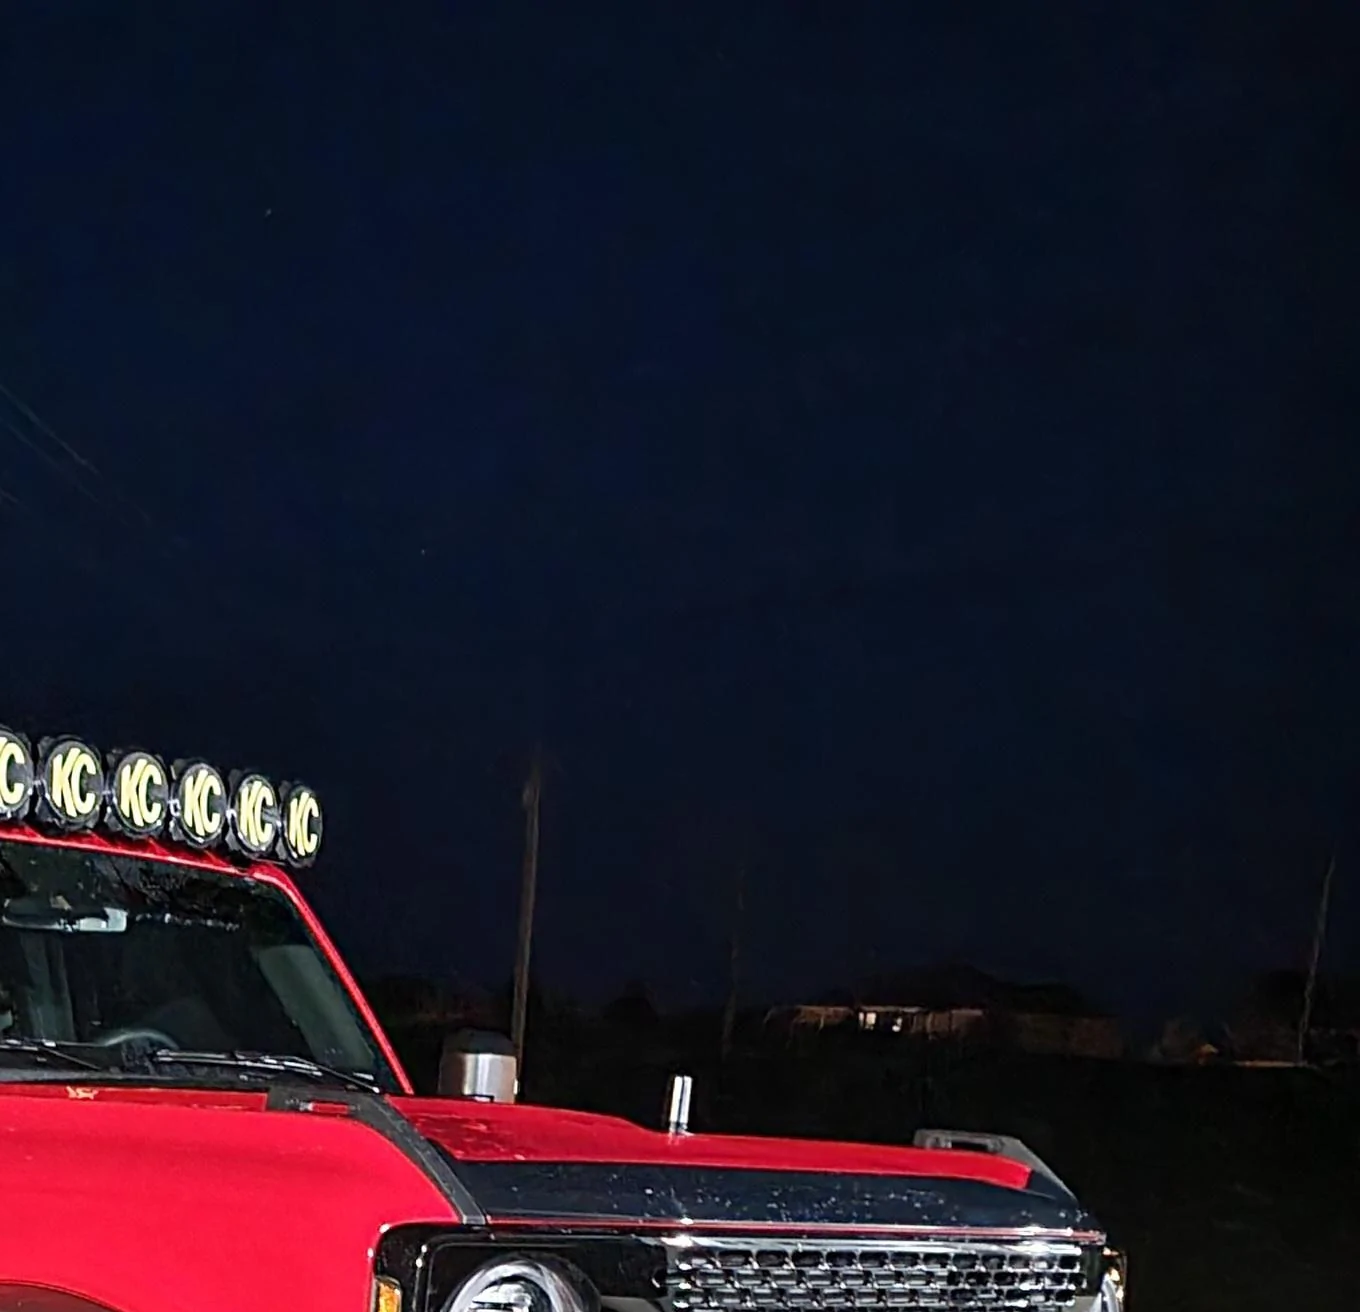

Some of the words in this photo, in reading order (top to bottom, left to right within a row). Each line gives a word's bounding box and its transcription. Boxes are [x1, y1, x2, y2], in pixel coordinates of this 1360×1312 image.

[51, 748, 97, 816] KC
[120, 759, 162, 826] KC
[184, 769, 221, 836] KC
[240, 781, 274, 846] KC
[288, 792, 318, 856] KC
